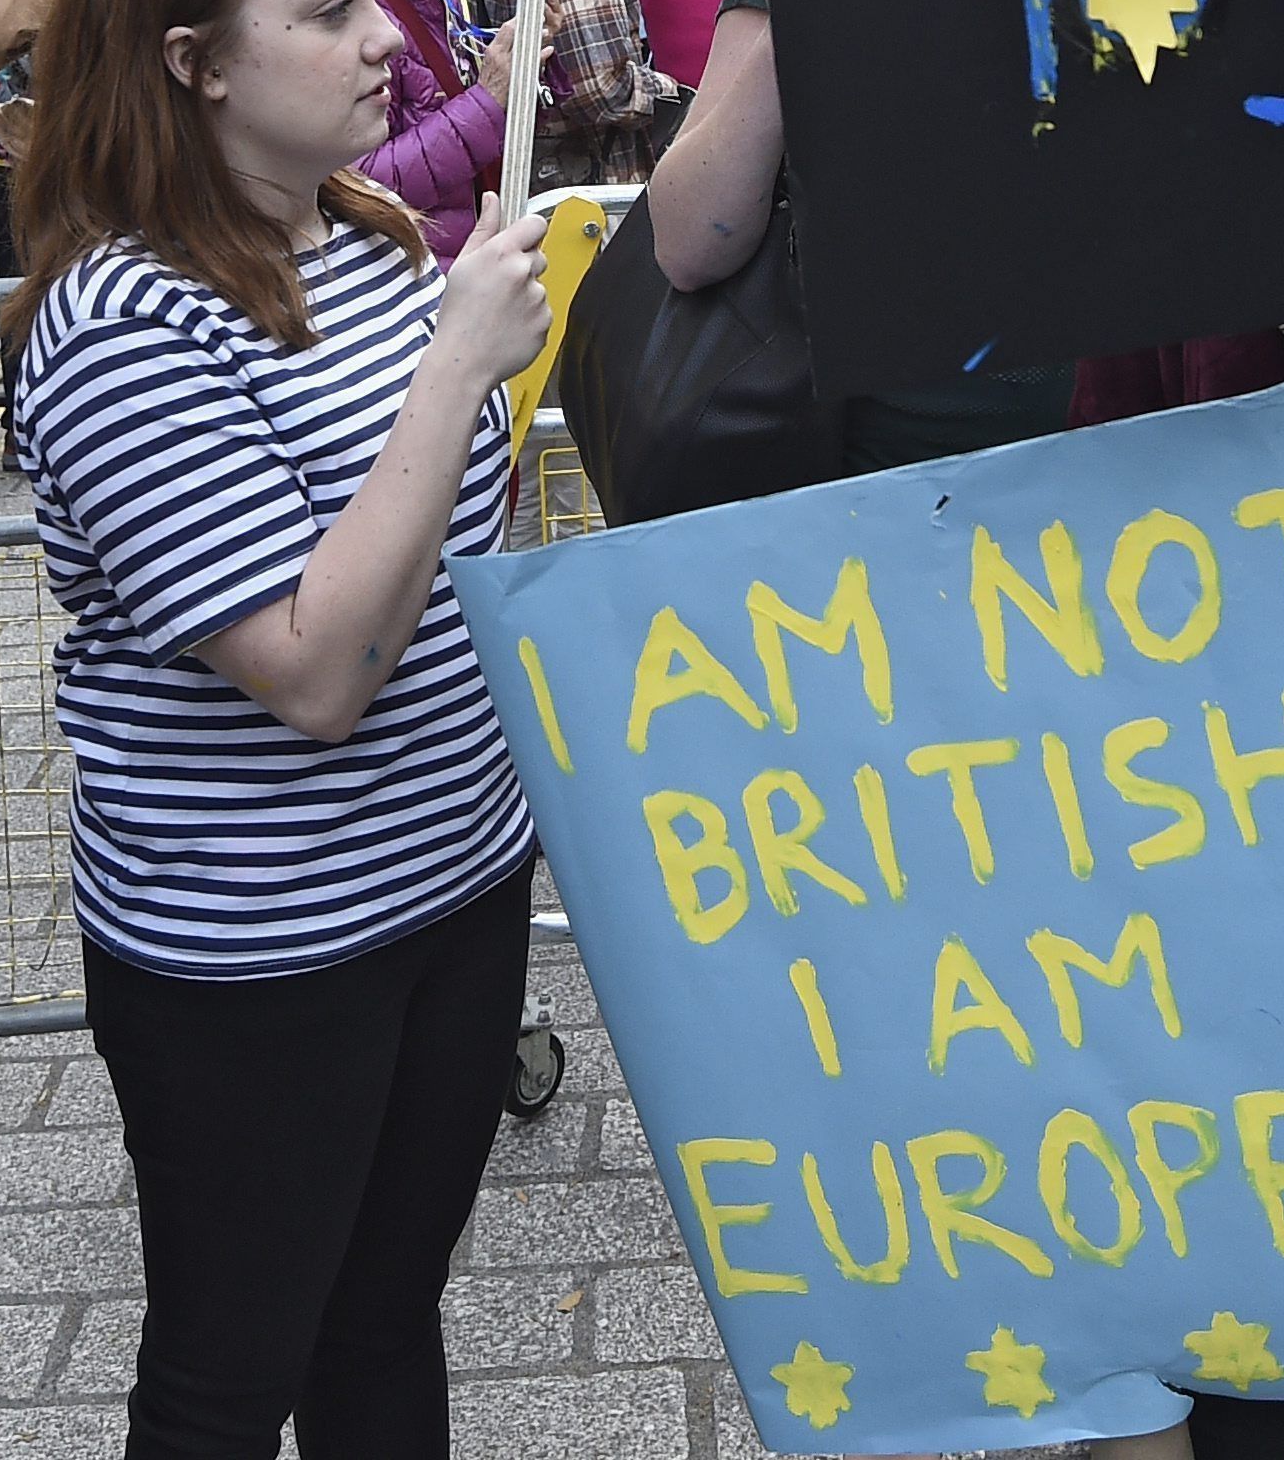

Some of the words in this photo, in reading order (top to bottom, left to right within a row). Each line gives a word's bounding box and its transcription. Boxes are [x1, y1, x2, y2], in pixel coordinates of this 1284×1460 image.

[519, 638, 574, 772] I
[629, 558, 892, 753] AM
[789, 957, 841, 1076] I
[927, 912, 1182, 1076] AM
